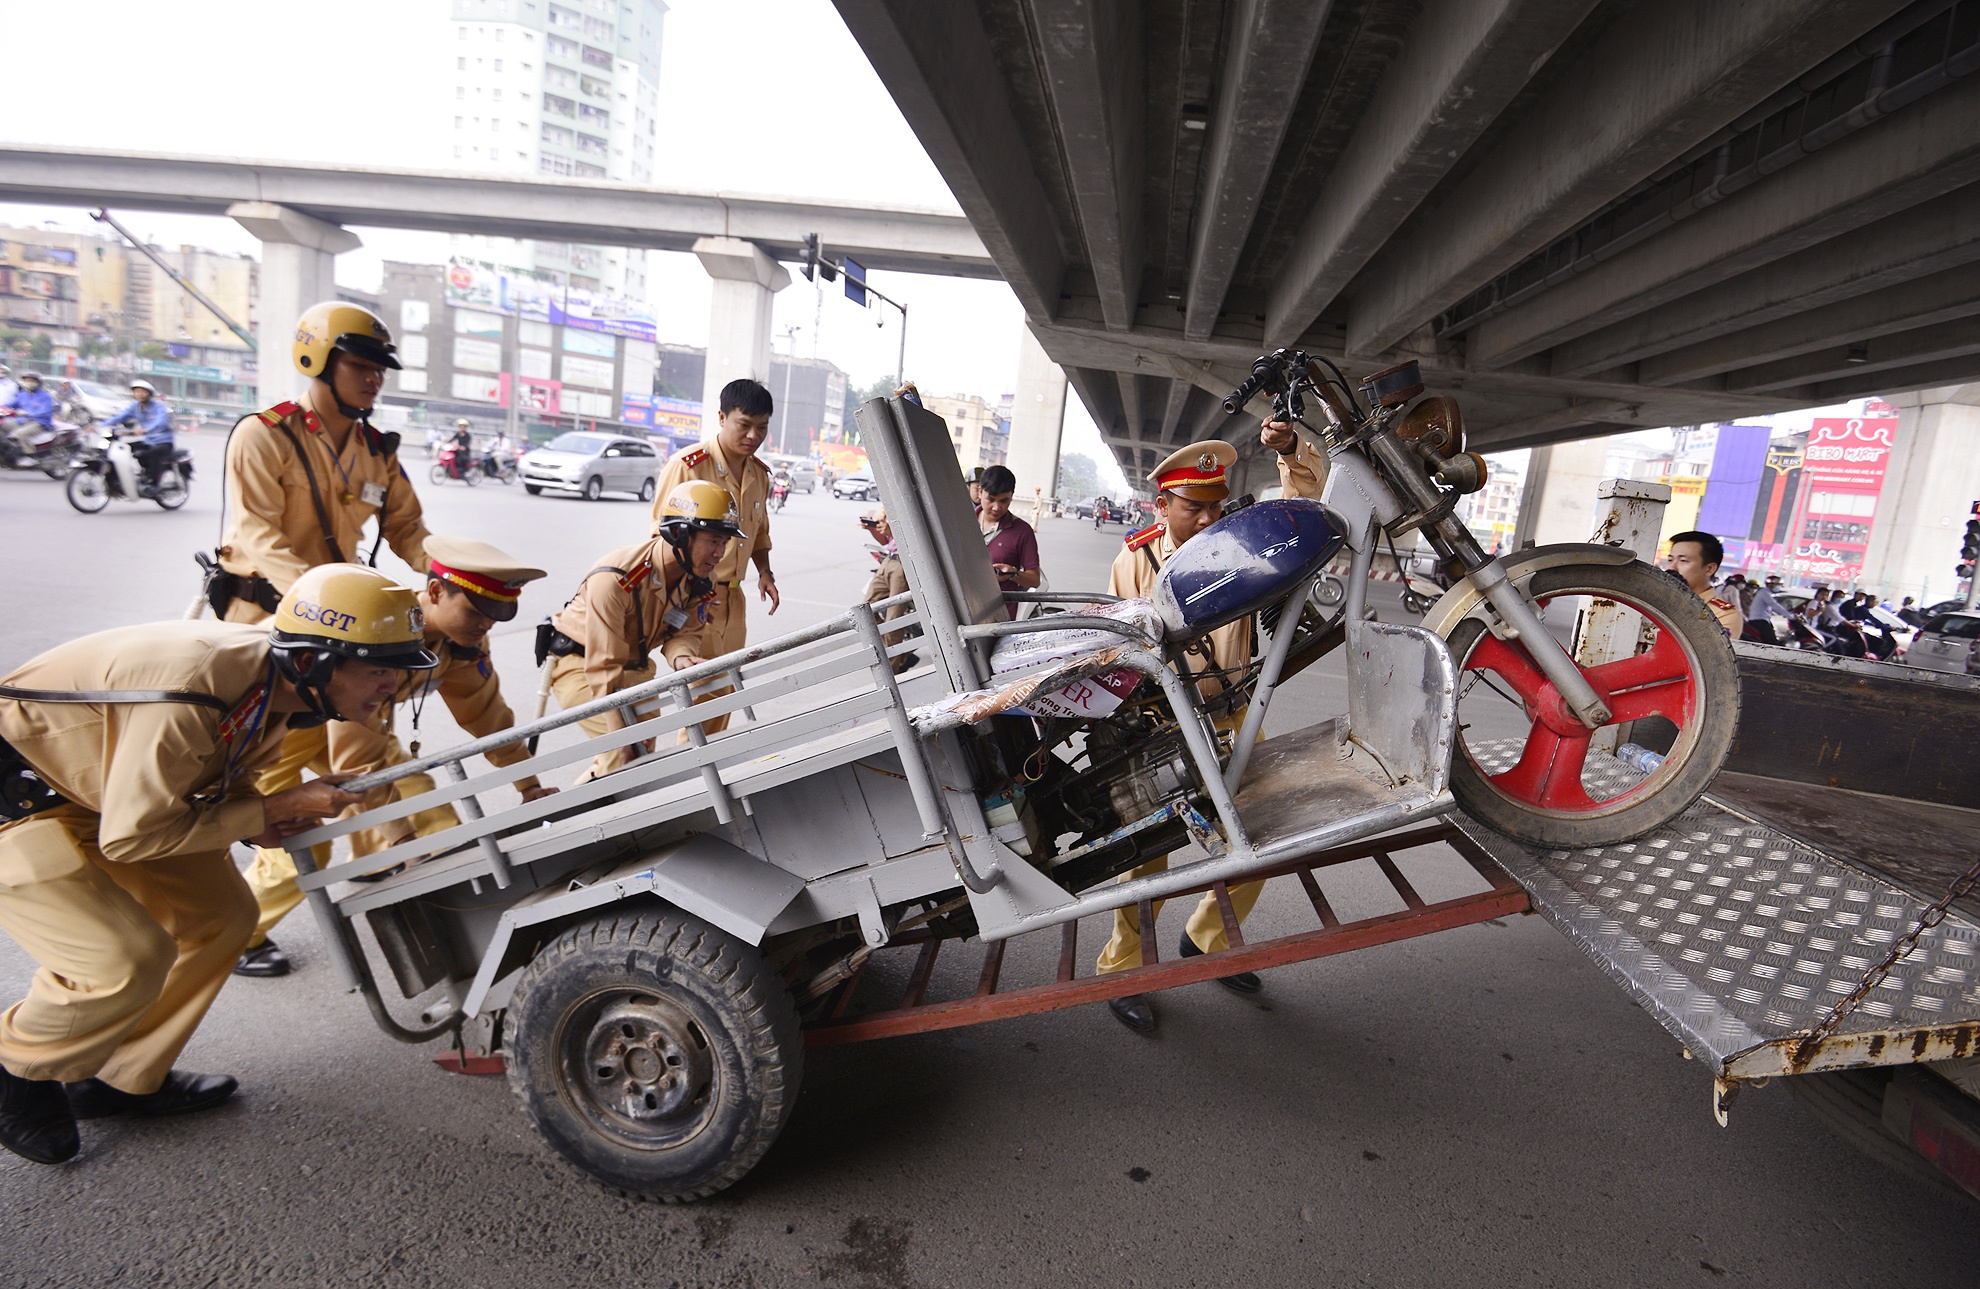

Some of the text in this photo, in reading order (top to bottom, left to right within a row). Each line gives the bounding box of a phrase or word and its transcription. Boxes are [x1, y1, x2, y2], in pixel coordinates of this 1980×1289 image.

[668, 417, 698, 427] JOTUN
[1805, 446, 1885, 462] BIBO MART
[669, 498, 699, 512] CSGT
[294, 600, 356, 632] CSGT
